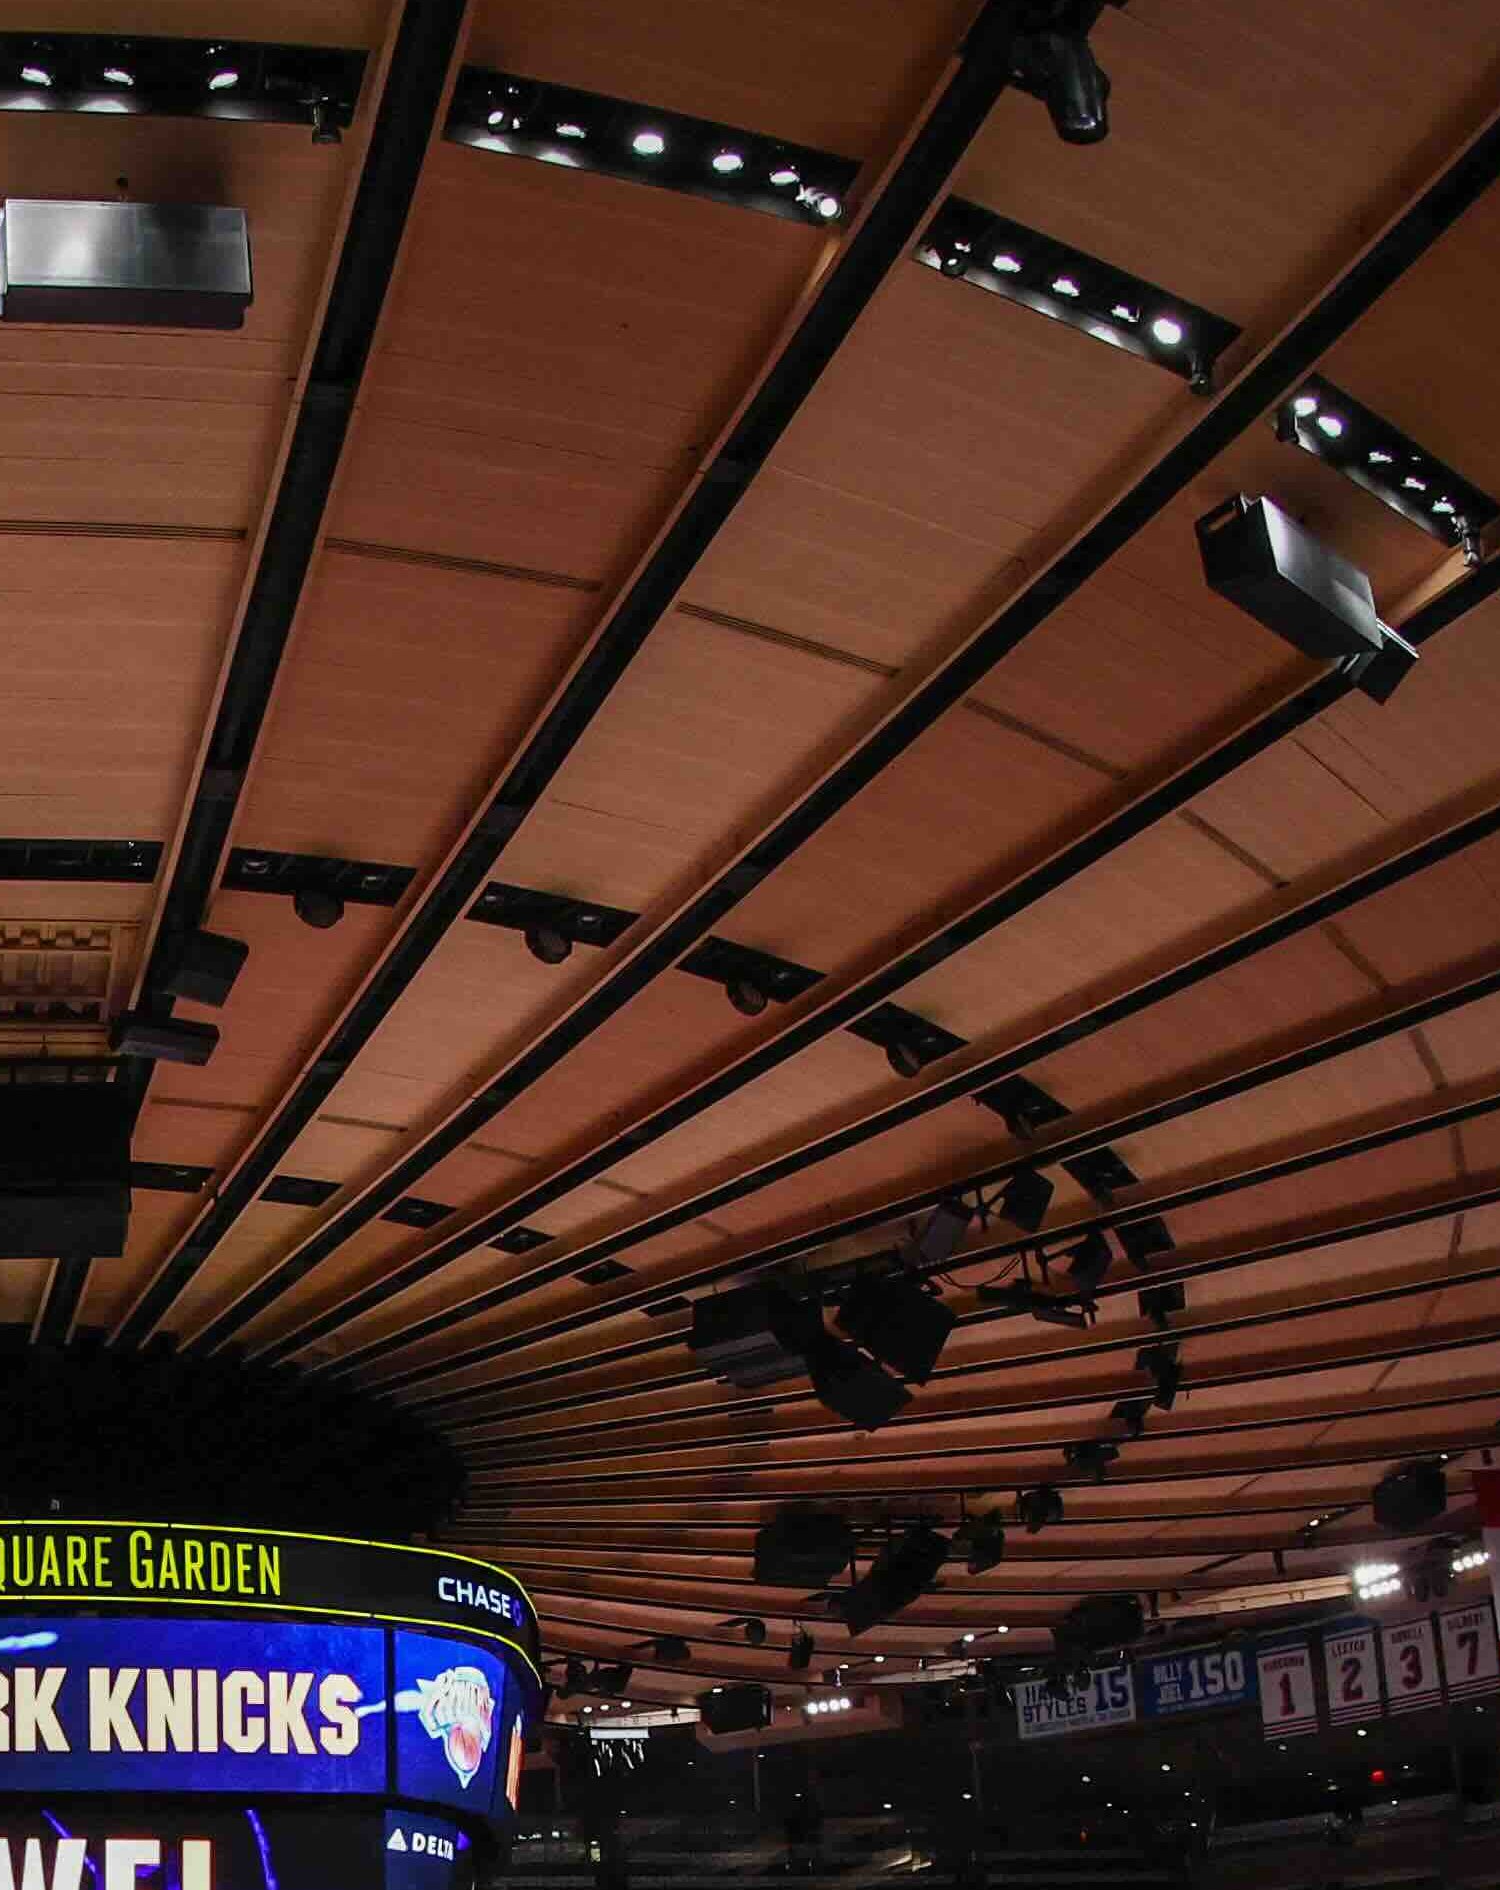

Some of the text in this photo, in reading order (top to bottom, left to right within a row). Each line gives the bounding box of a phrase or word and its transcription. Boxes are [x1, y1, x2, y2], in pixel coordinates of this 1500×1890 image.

[129, 1531, 282, 1598] GARDEN
[439, 1577, 512, 1619] CHASE
[1189, 1650, 1247, 1699] 150
[1400, 1646, 1422, 1689] 3
[1457, 1631, 1478, 1675] 7
[1096, 1670, 1129, 1711] 15
[1280, 1673, 1296, 1716] 1
[1341, 1658, 1362, 1701] 2
[91, 1667, 362, 1757] KNICKS
[1024, 1697, 1087, 1722] STYLES
[411, 1832, 454, 1861] DELTA
